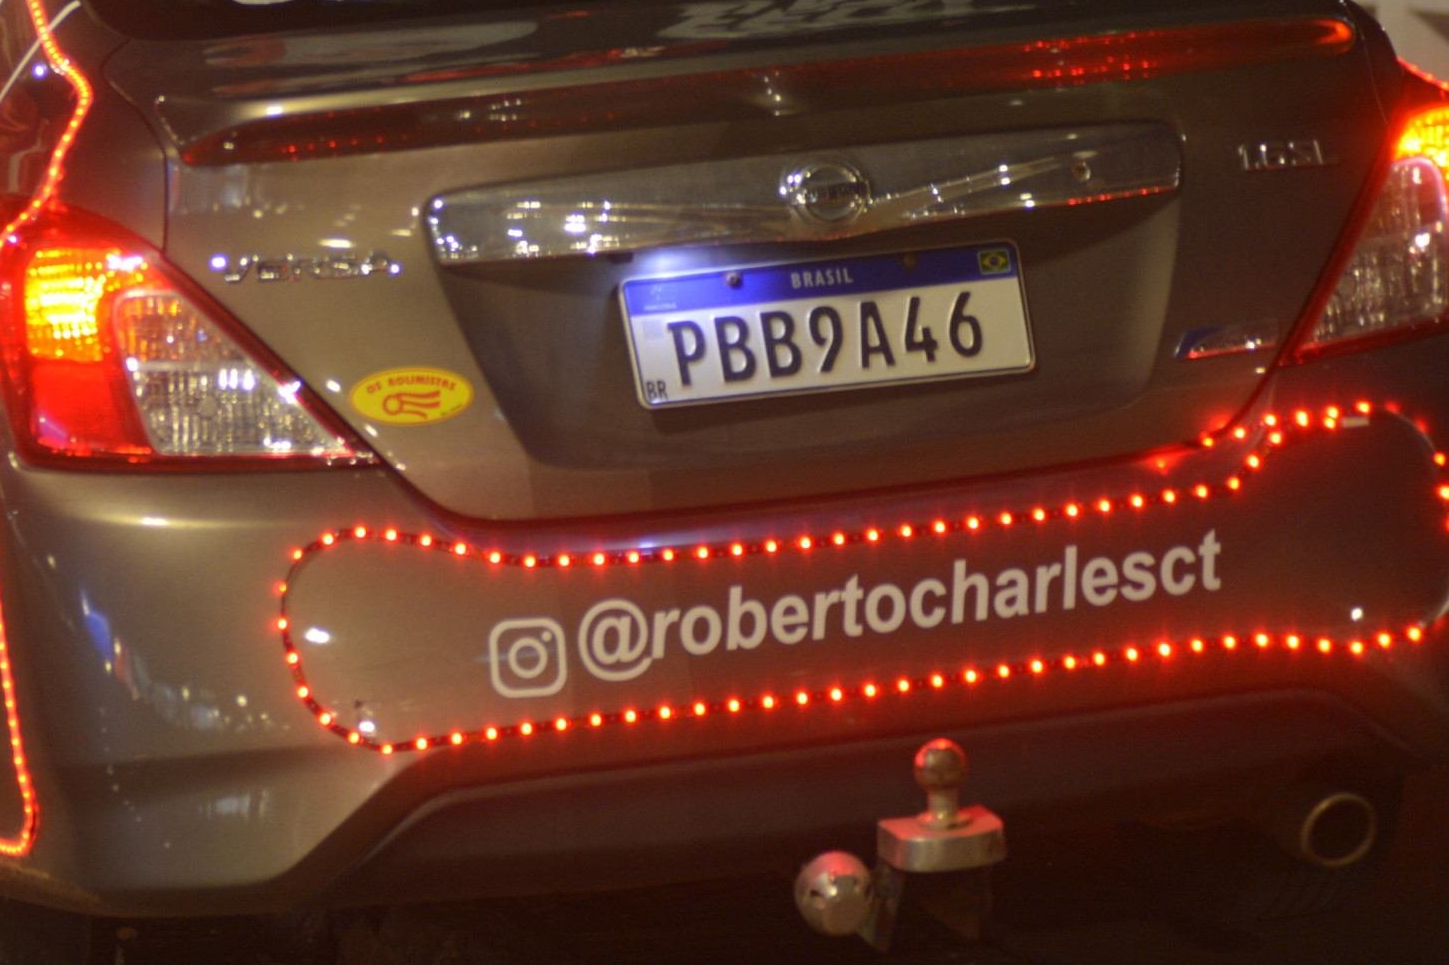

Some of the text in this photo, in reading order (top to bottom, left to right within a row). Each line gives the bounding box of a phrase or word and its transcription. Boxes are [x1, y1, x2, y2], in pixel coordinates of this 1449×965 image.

[790, 267, 854, 289] BRASIL
[667, 291, 983, 386] PBB9A46
[645, 381, 668, 402] BR
[579, 530, 1222, 681] @robertocharlesct
